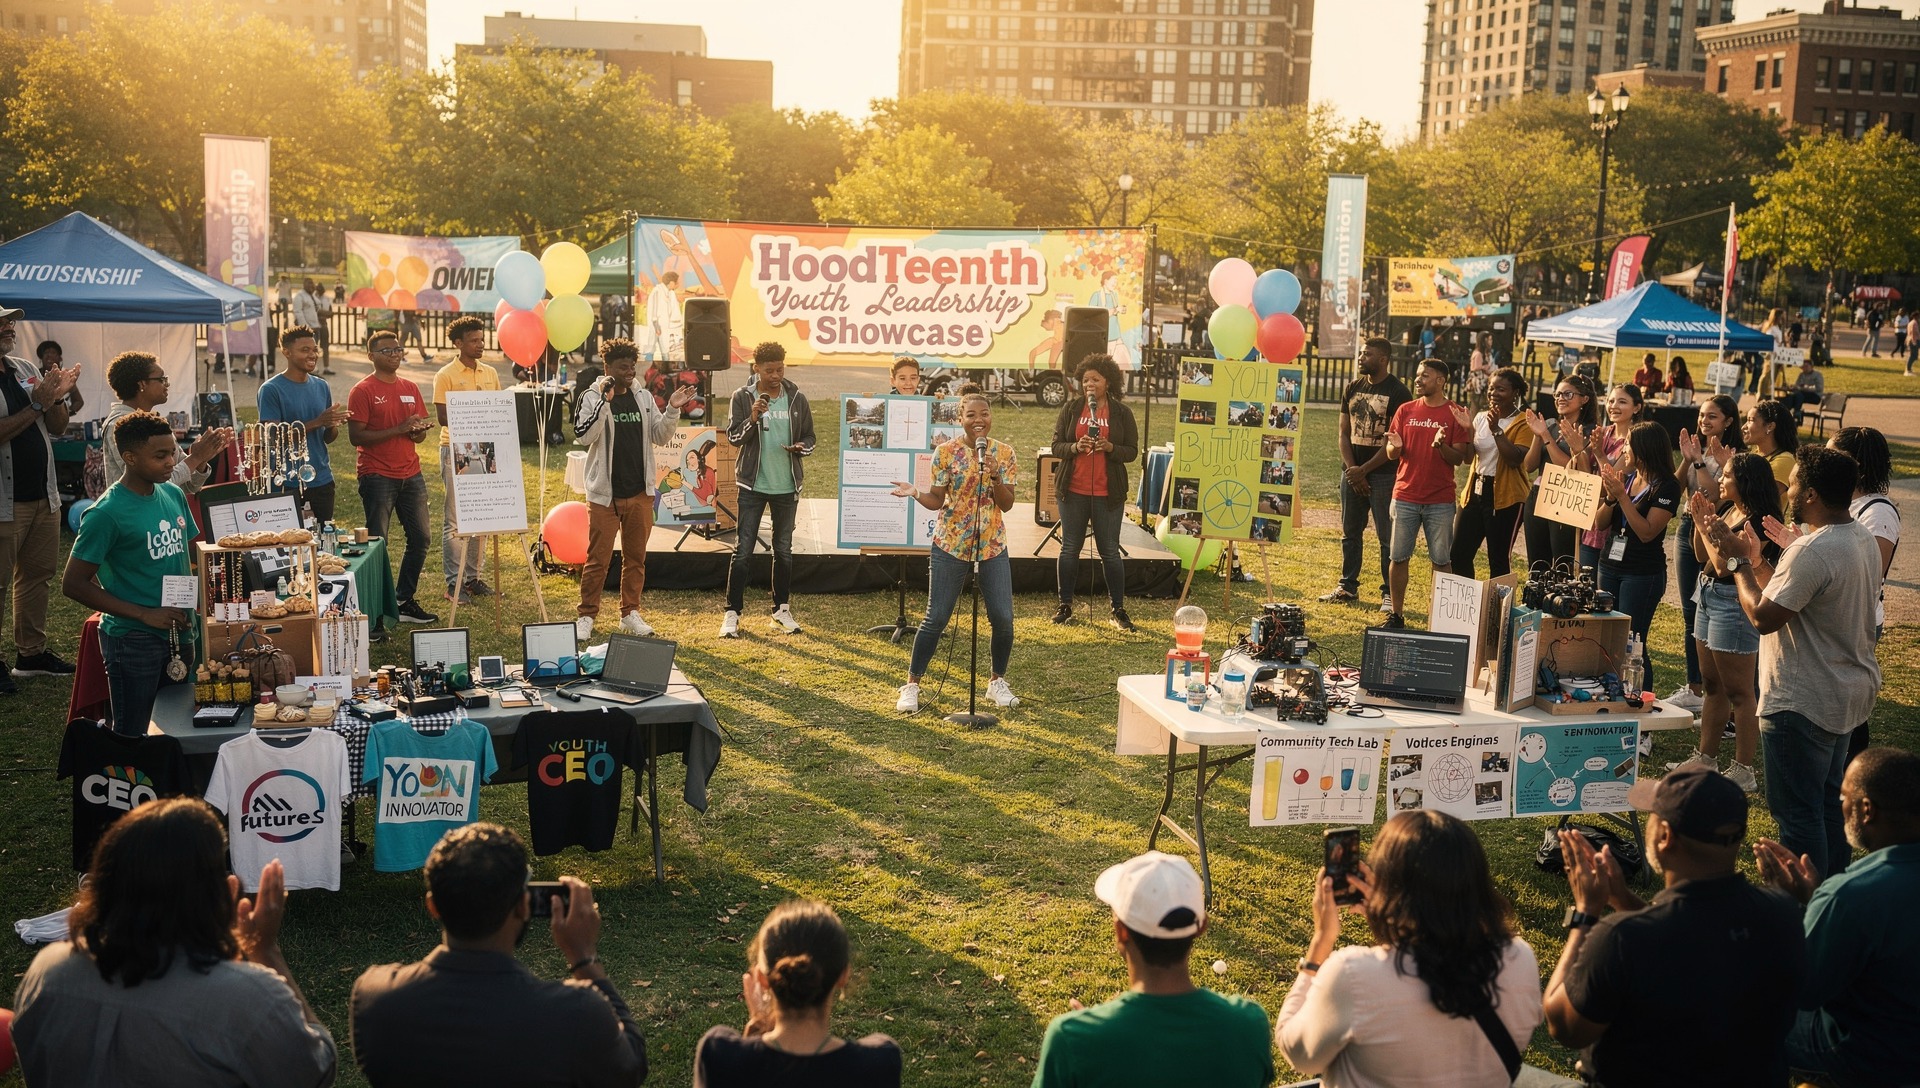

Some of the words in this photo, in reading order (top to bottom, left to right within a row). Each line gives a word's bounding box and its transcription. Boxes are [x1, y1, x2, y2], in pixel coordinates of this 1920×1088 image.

[758, 243, 1038, 285] HoodTeenth
[767, 283, 850, 317] Youth
[865, 280, 1023, 324] Leadership
[816, 316, 984, 346] Showcase
[1260, 737, 1326, 749] Community
[1329, 736, 1354, 747] Tech
[1358, 737, 1379, 749] Lab
[537, 750, 615, 787] CEO
[82, 774, 157, 811] CEO
[385, 802, 464, 817] INNOVATOR
